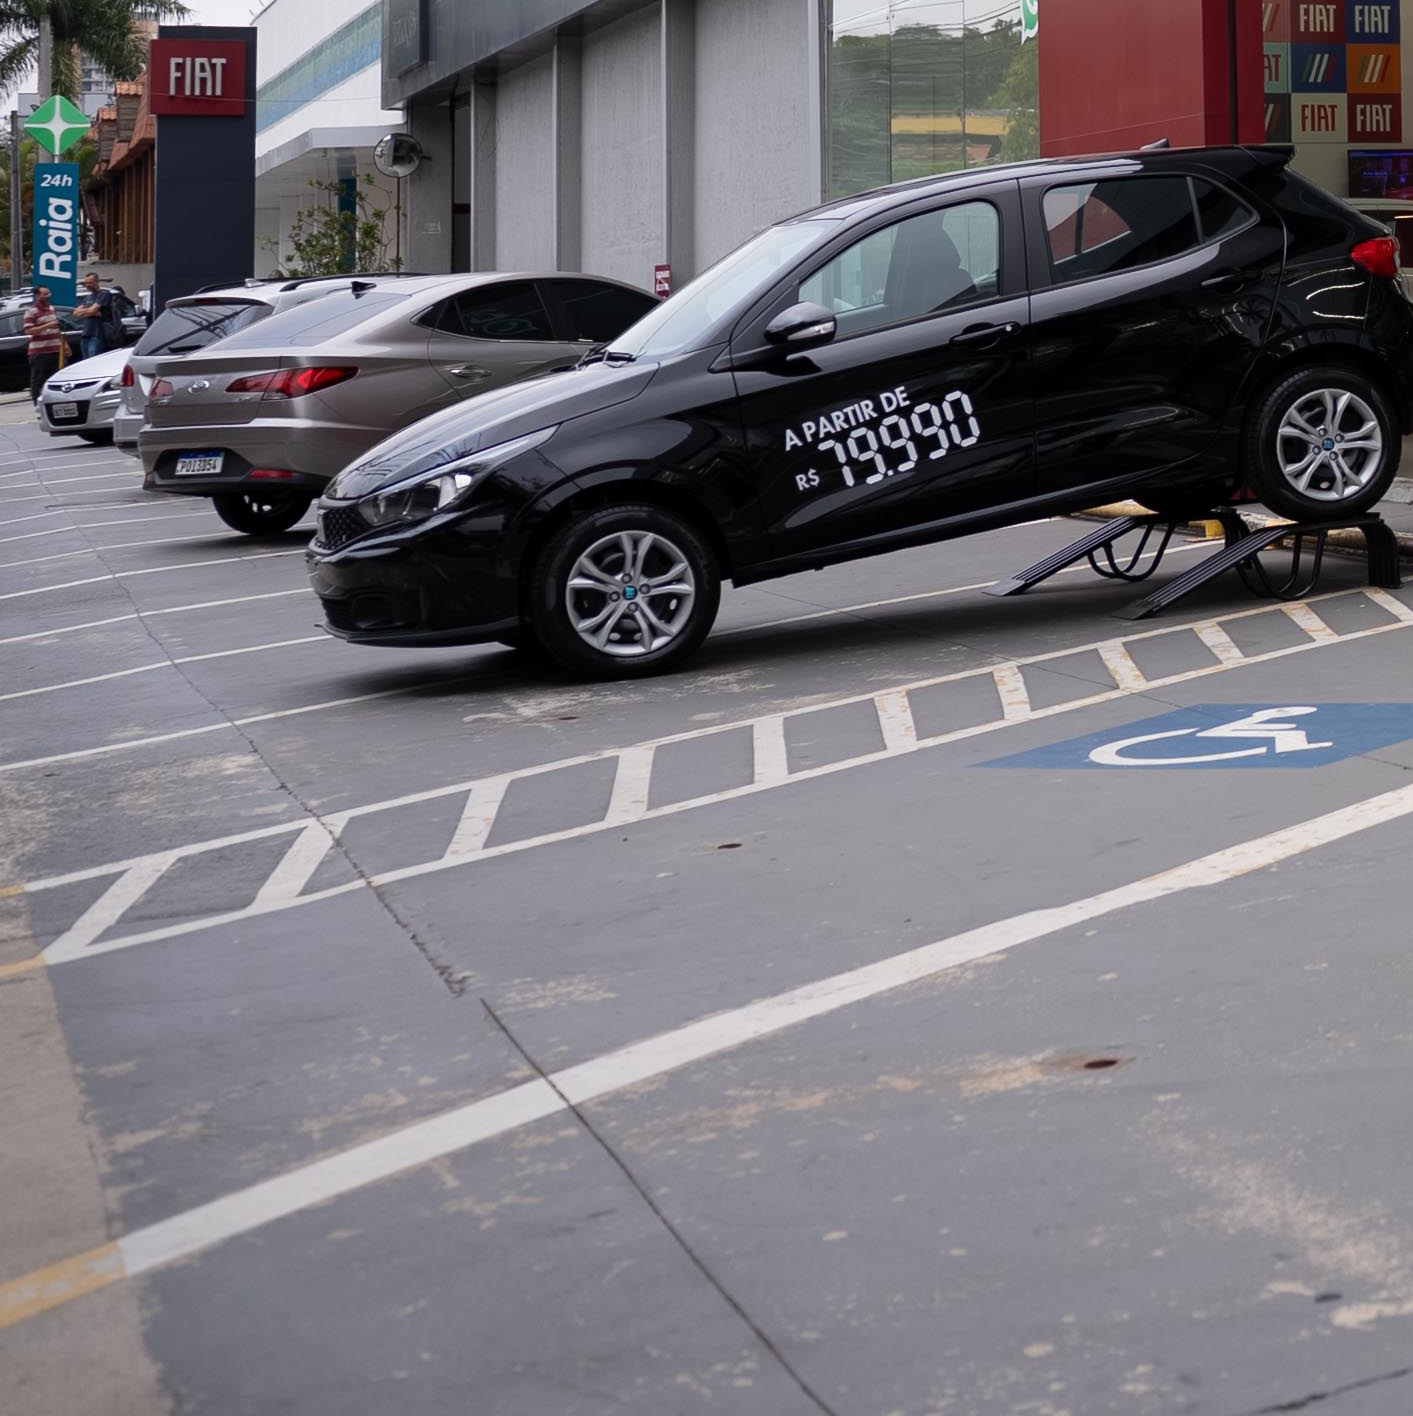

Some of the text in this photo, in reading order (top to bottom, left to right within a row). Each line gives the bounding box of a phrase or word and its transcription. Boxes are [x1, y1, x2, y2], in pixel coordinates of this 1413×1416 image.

[1300, 4, 1336, 33] FIAT
[1355, 5, 1391, 34] FIAT
[169, 57, 227, 96] FIAT
[1301, 104, 1337, 132] FIAT
[1356, 104, 1392, 132] FIAT
[40, 174, 73, 187] 24h
[38, 197, 73, 279] Raia
[785, 386, 910, 451] A PARTIR DE
[795, 390, 981, 491] R$ 79.990
